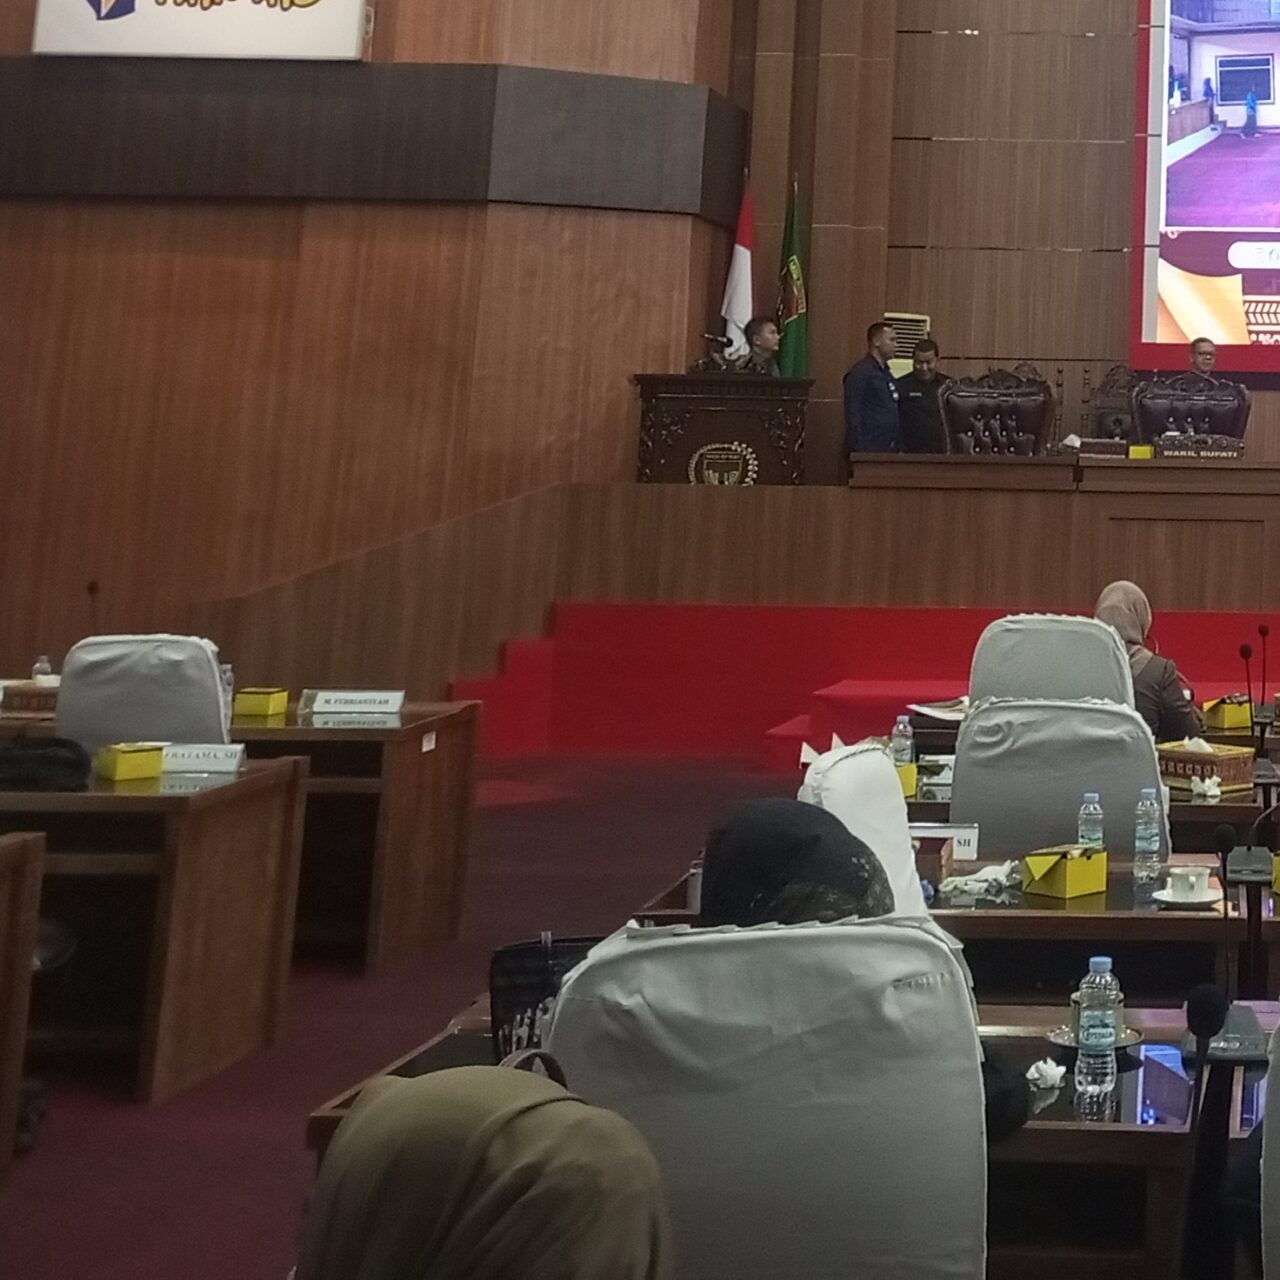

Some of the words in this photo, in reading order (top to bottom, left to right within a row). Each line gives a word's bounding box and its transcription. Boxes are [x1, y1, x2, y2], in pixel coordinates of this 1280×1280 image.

[1163, 449, 1197, 458] WAKIL
[1200, 450, 1238, 459] BUPATI
[956, 838, 971, 847] SH
